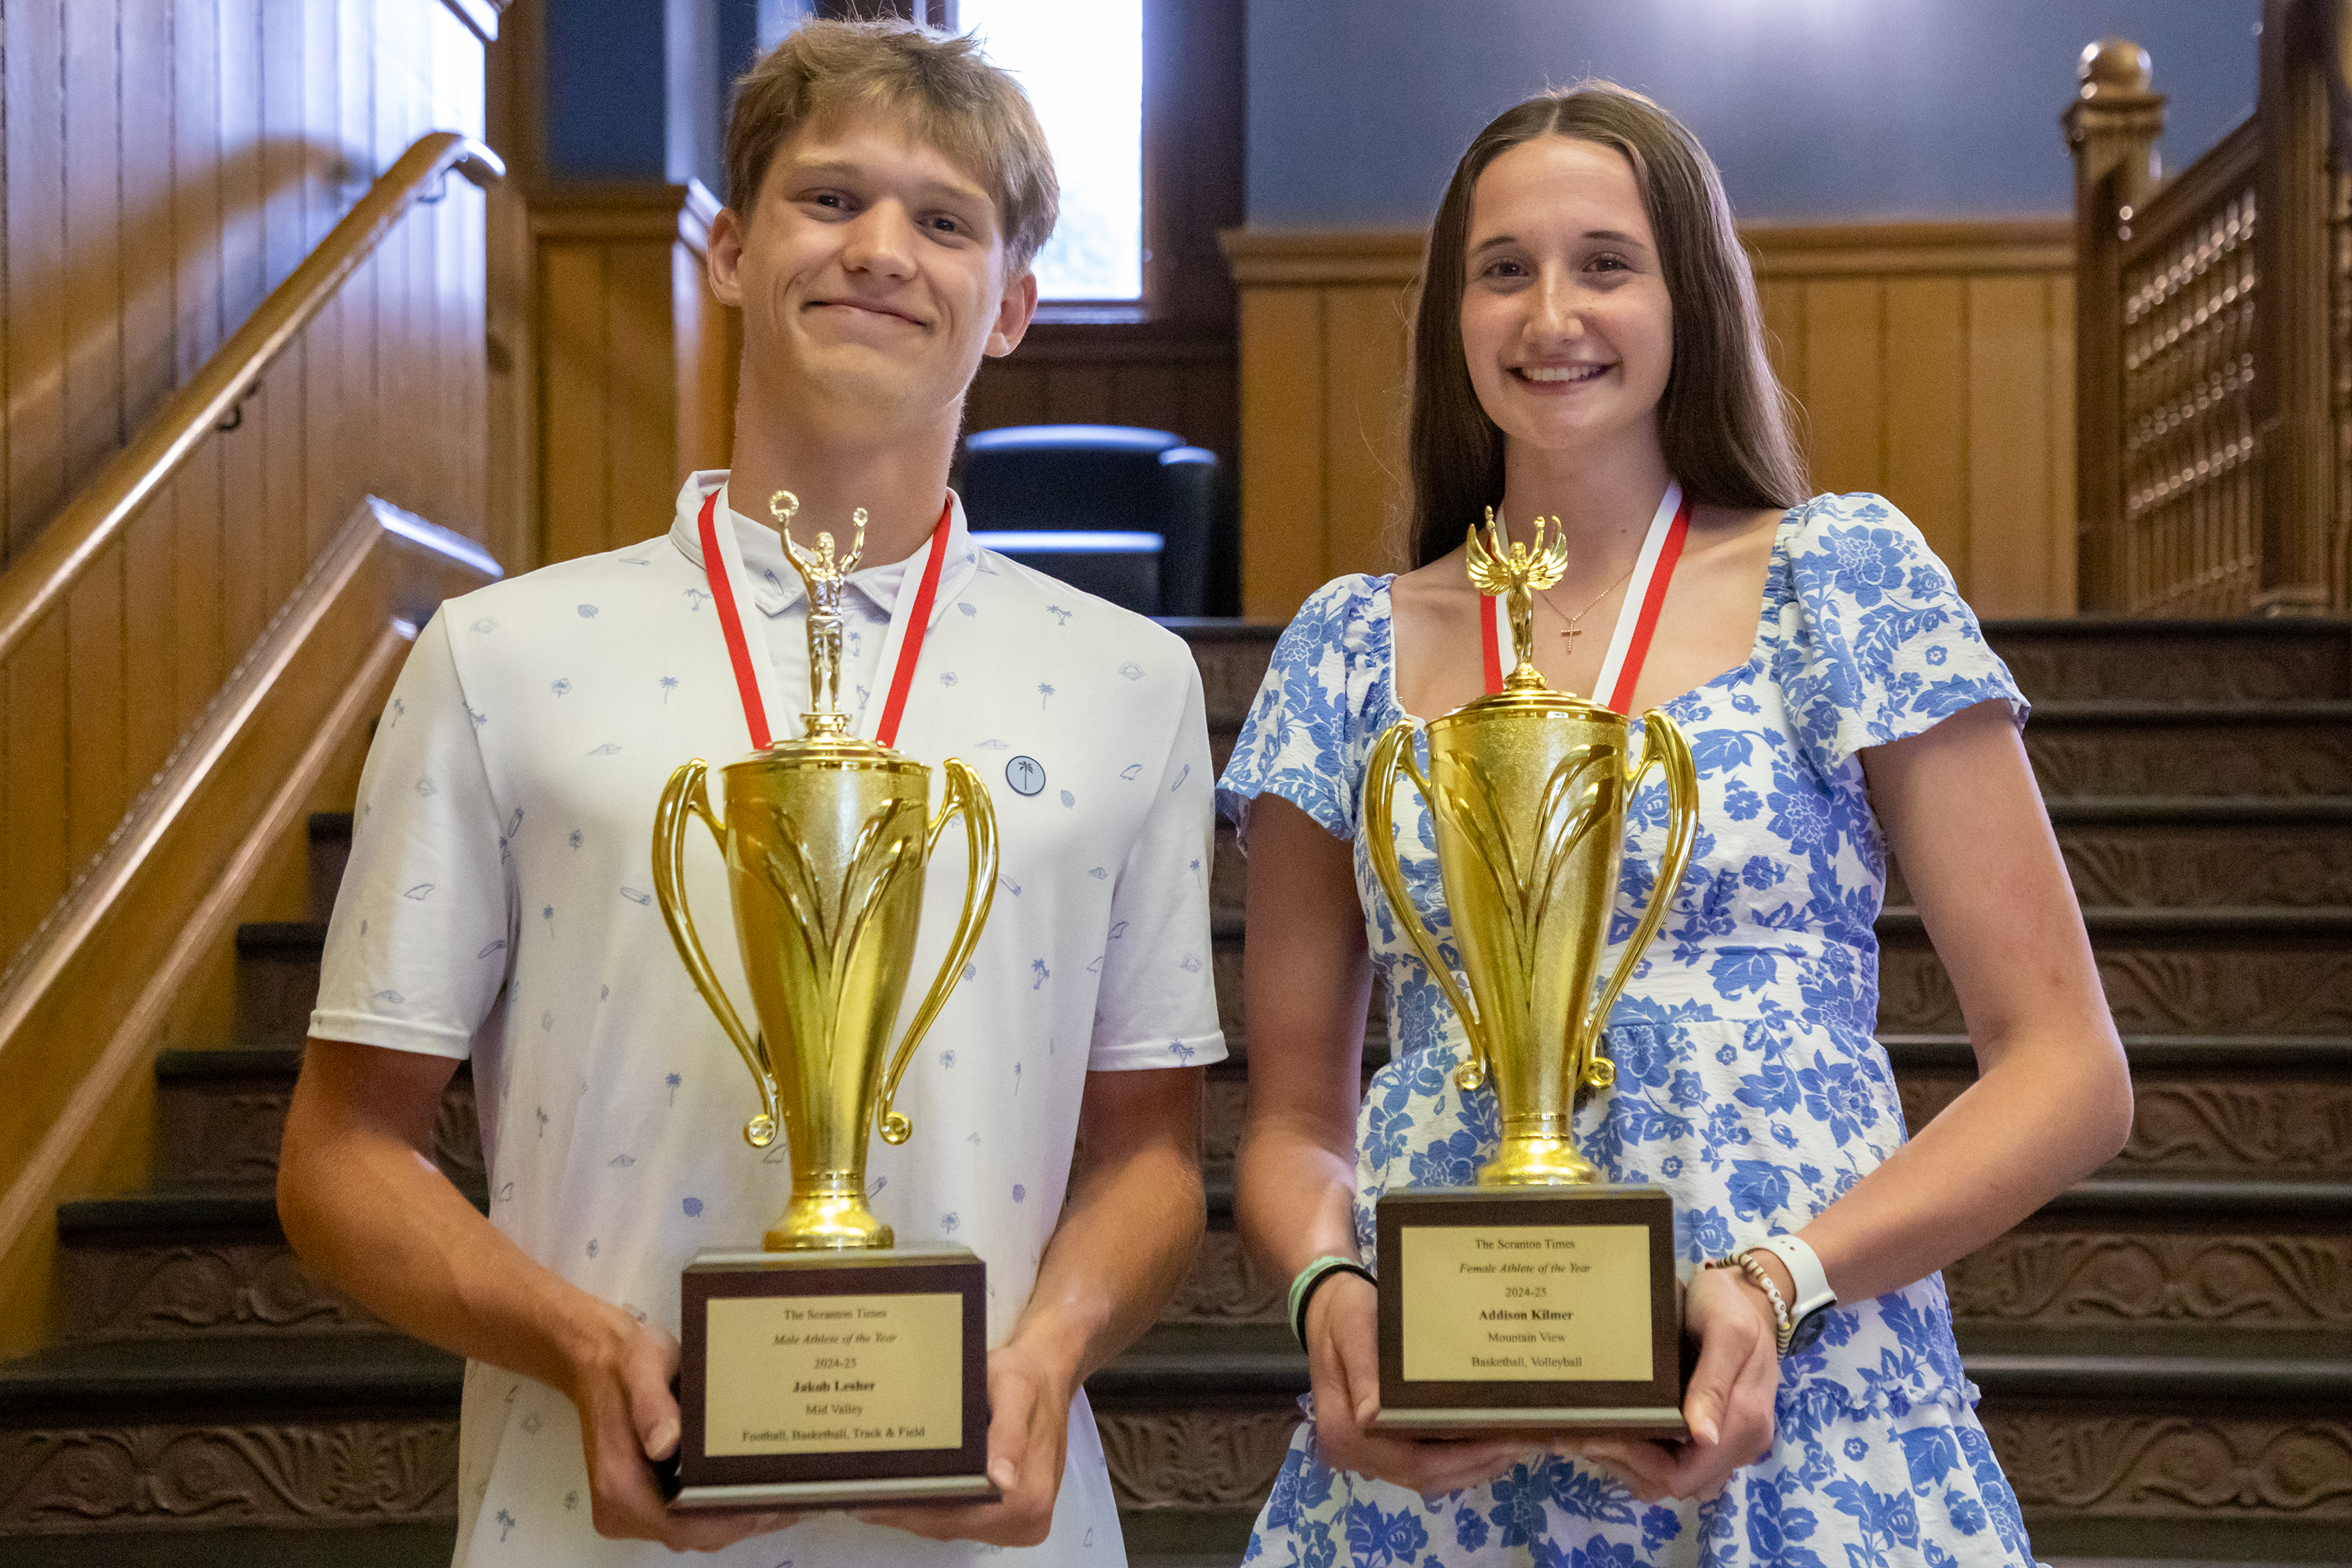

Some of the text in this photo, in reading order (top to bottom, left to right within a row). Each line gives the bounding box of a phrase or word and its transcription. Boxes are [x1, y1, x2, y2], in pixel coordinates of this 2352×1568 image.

[1475, 1240, 1575, 1249] The Scranton Times
[1460, 1264, 1592, 1275] Female Athlete of the Year
[1505, 1288, 1547, 1298] 2024-25
[1479, 1310, 1574, 1320] Addison Kilmer
[1488, 1333, 1566, 1343] Mountain View
[1531, 1357, 1582, 1370] Volleyball
